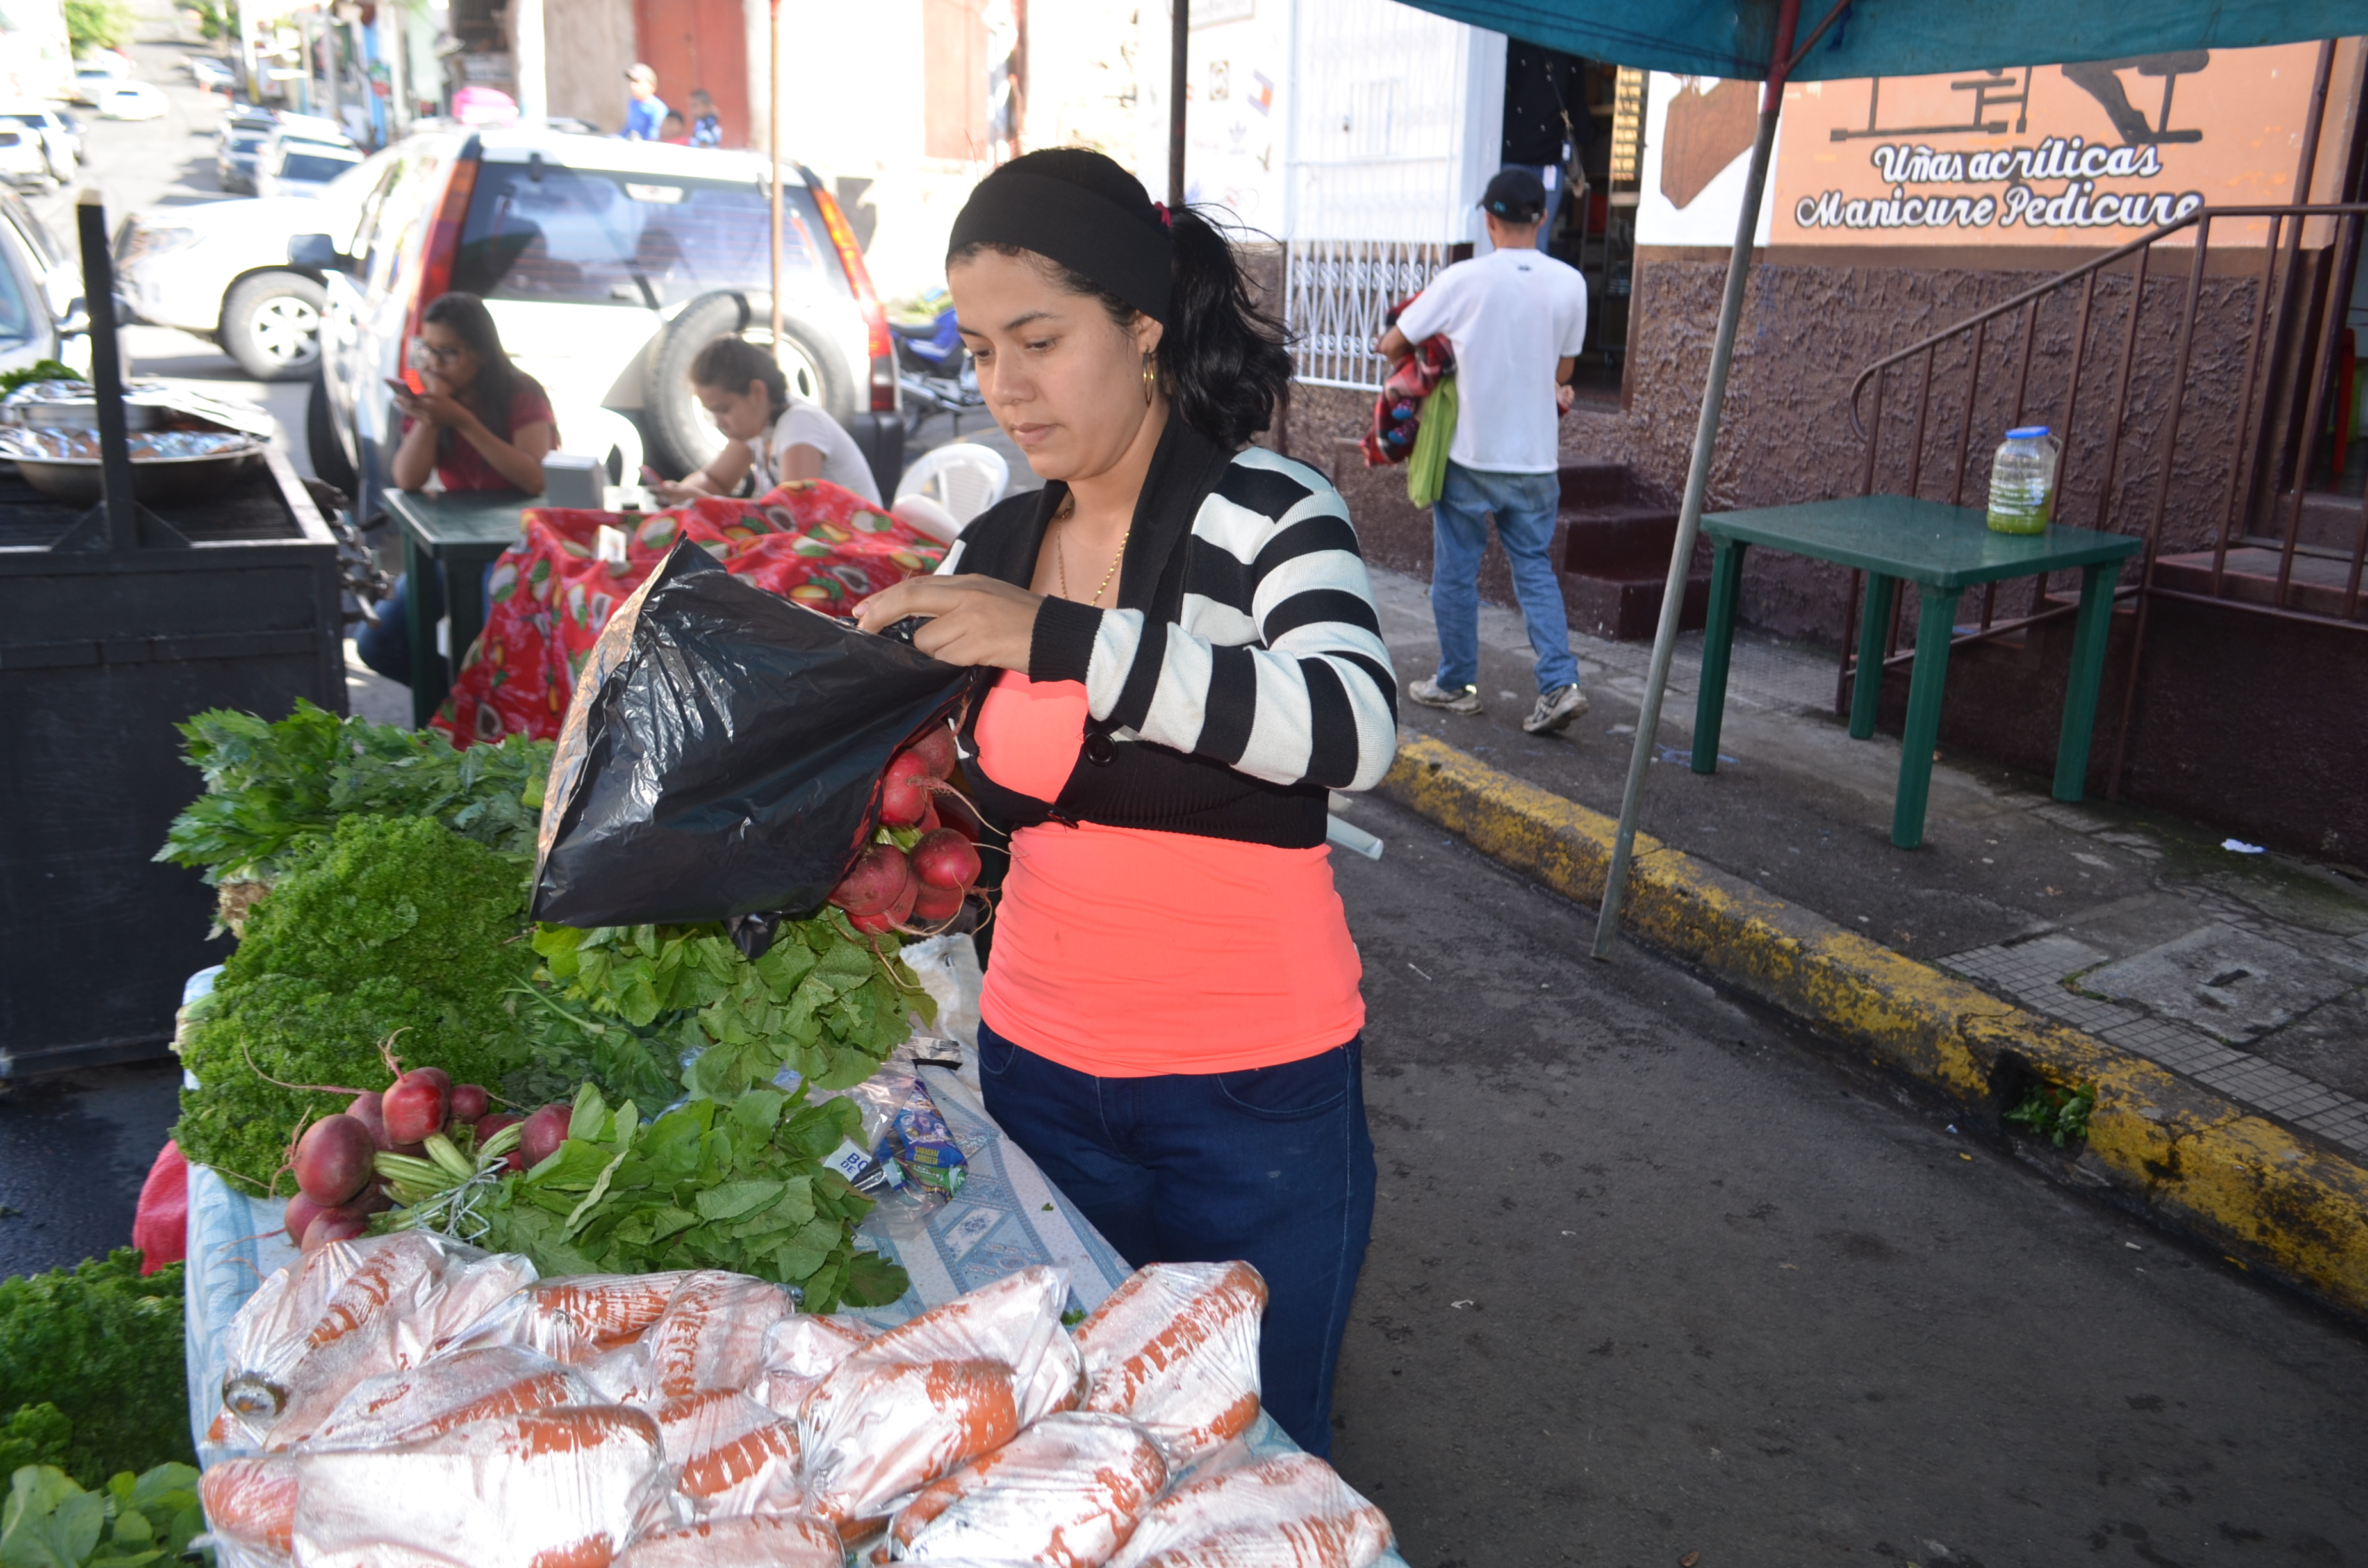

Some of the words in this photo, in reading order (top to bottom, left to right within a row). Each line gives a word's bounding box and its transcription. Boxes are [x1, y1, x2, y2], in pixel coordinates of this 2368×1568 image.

[1871, 143, 1964, 183] Uñas
[1966, 135, 2164, 181] acrílicas
[1796, 183, 1997, 229] Manicure
[1999, 179, 2205, 229] Pedicure
[840, 1160, 857, 1174] DE
